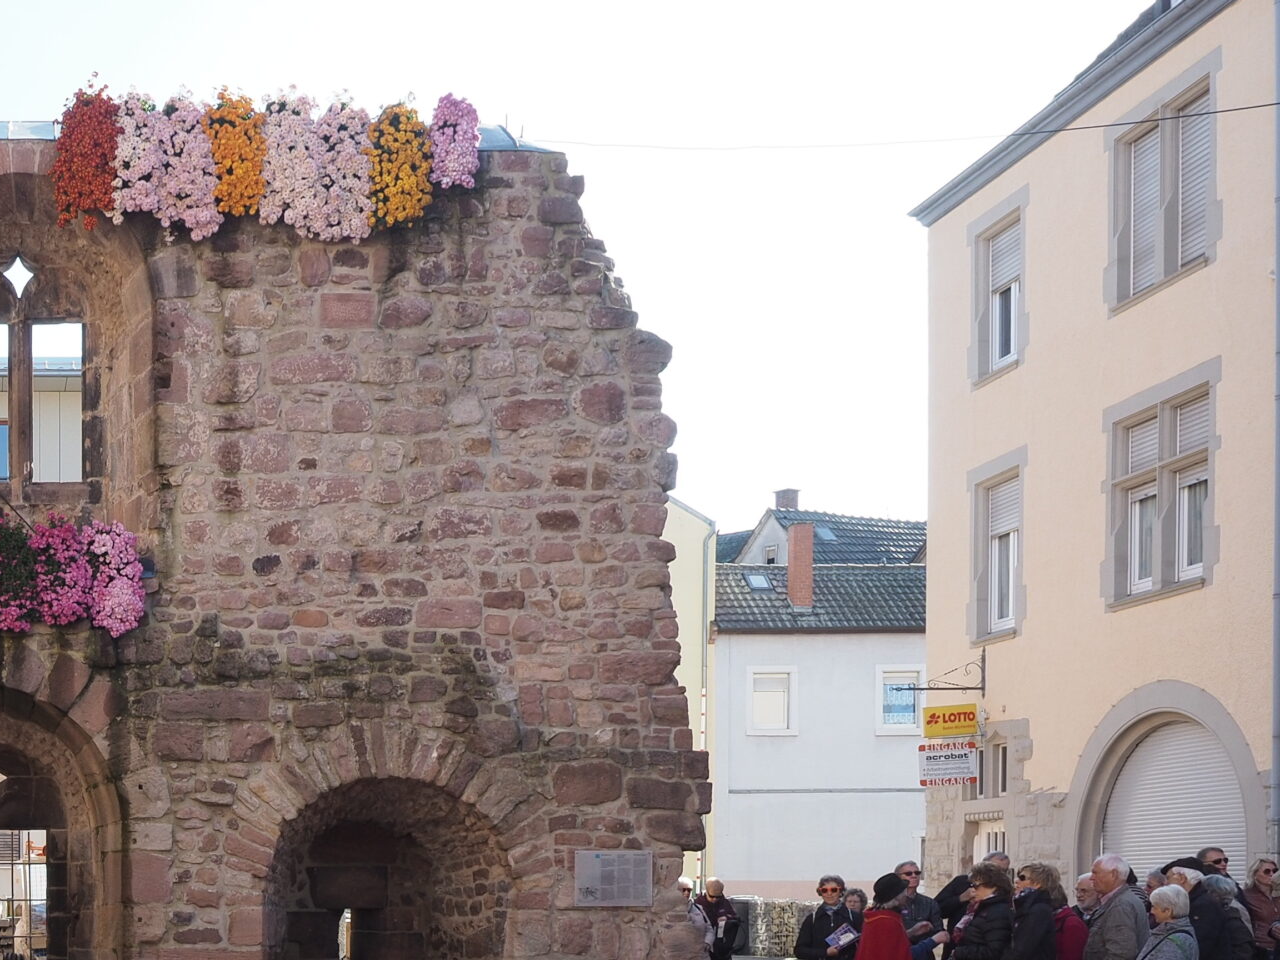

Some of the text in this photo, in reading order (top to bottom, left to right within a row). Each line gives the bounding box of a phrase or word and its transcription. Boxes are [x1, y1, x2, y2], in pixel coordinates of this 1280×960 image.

[942, 711, 976, 723] LOTTO
[925, 742, 969, 752] EINGANG
[925, 752, 969, 760] acrobat
[926, 777, 971, 786] EINGANG
